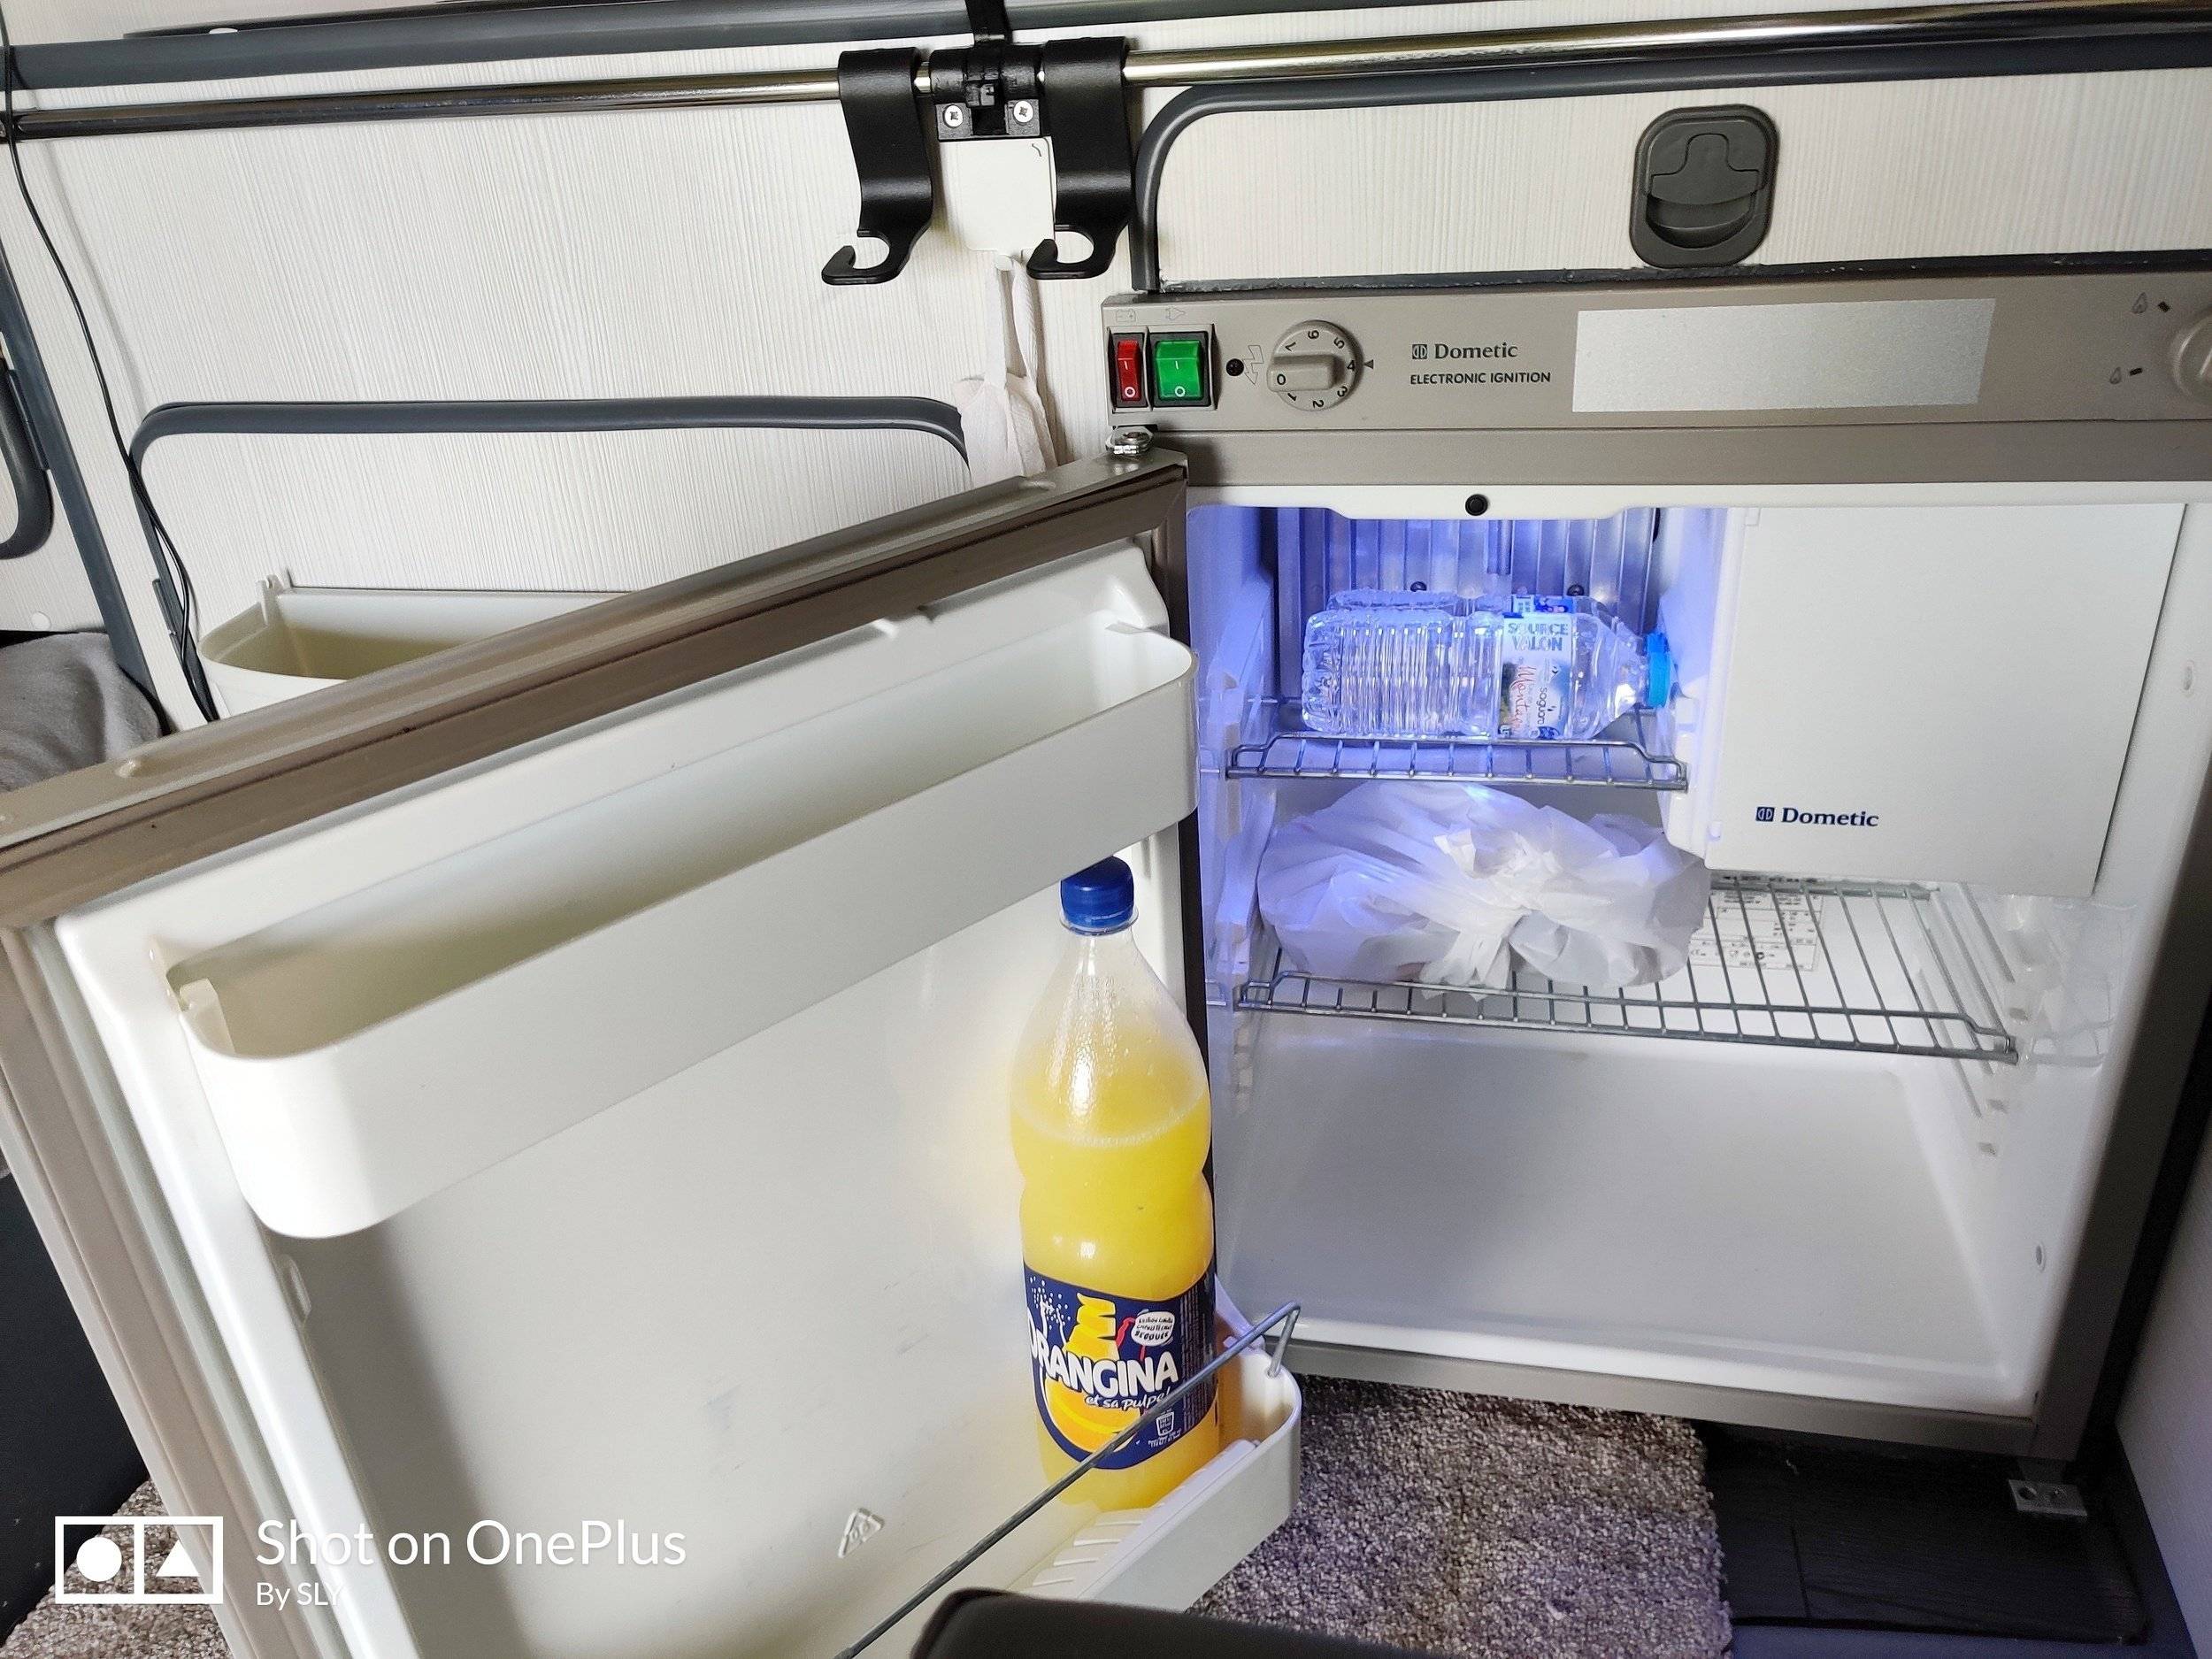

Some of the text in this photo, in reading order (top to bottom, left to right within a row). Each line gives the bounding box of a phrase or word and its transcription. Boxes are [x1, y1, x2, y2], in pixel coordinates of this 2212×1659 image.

[1285, 342, 1296, 351] 7
[1333, 337, 1345, 349] 5
[1434, 342, 1518, 359] Dometic
[1347, 360, 1356, 372] 4
[1410, 372, 1550, 384] ELECTRONIC IGNITION
[1337, 386, 1348, 397] 3
[1313, 400, 1324, 409] 2
[1781, 807, 1879, 827] Dometic
